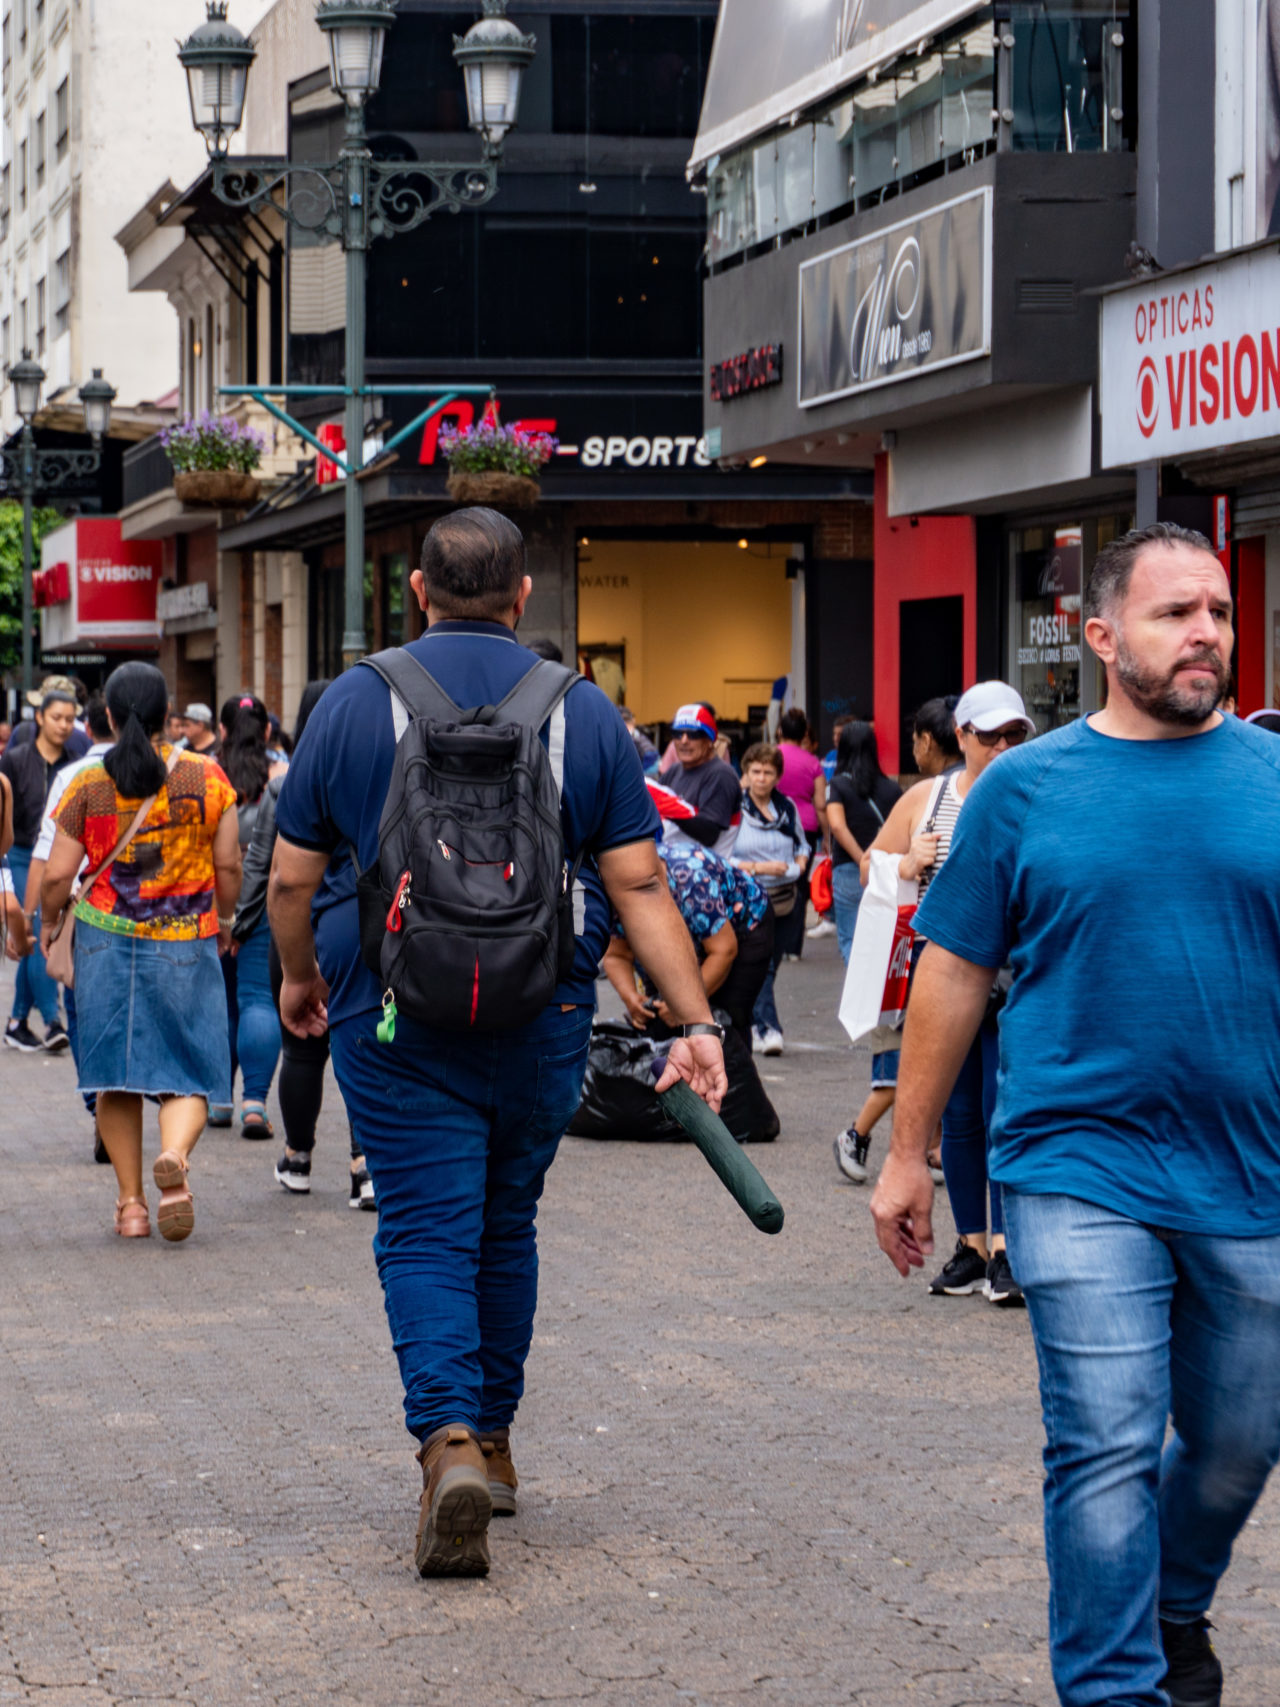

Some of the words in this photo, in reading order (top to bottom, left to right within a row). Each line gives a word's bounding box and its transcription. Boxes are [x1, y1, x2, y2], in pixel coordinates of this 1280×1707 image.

[1135, 284, 1214, 345] OPTICAS
[1165, 327, 1280, 431] VISION
[581, 436, 711, 467] SPORTS
[95, 565, 152, 582] VISION
[1029, 613, 1071, 646] FOSSIL
